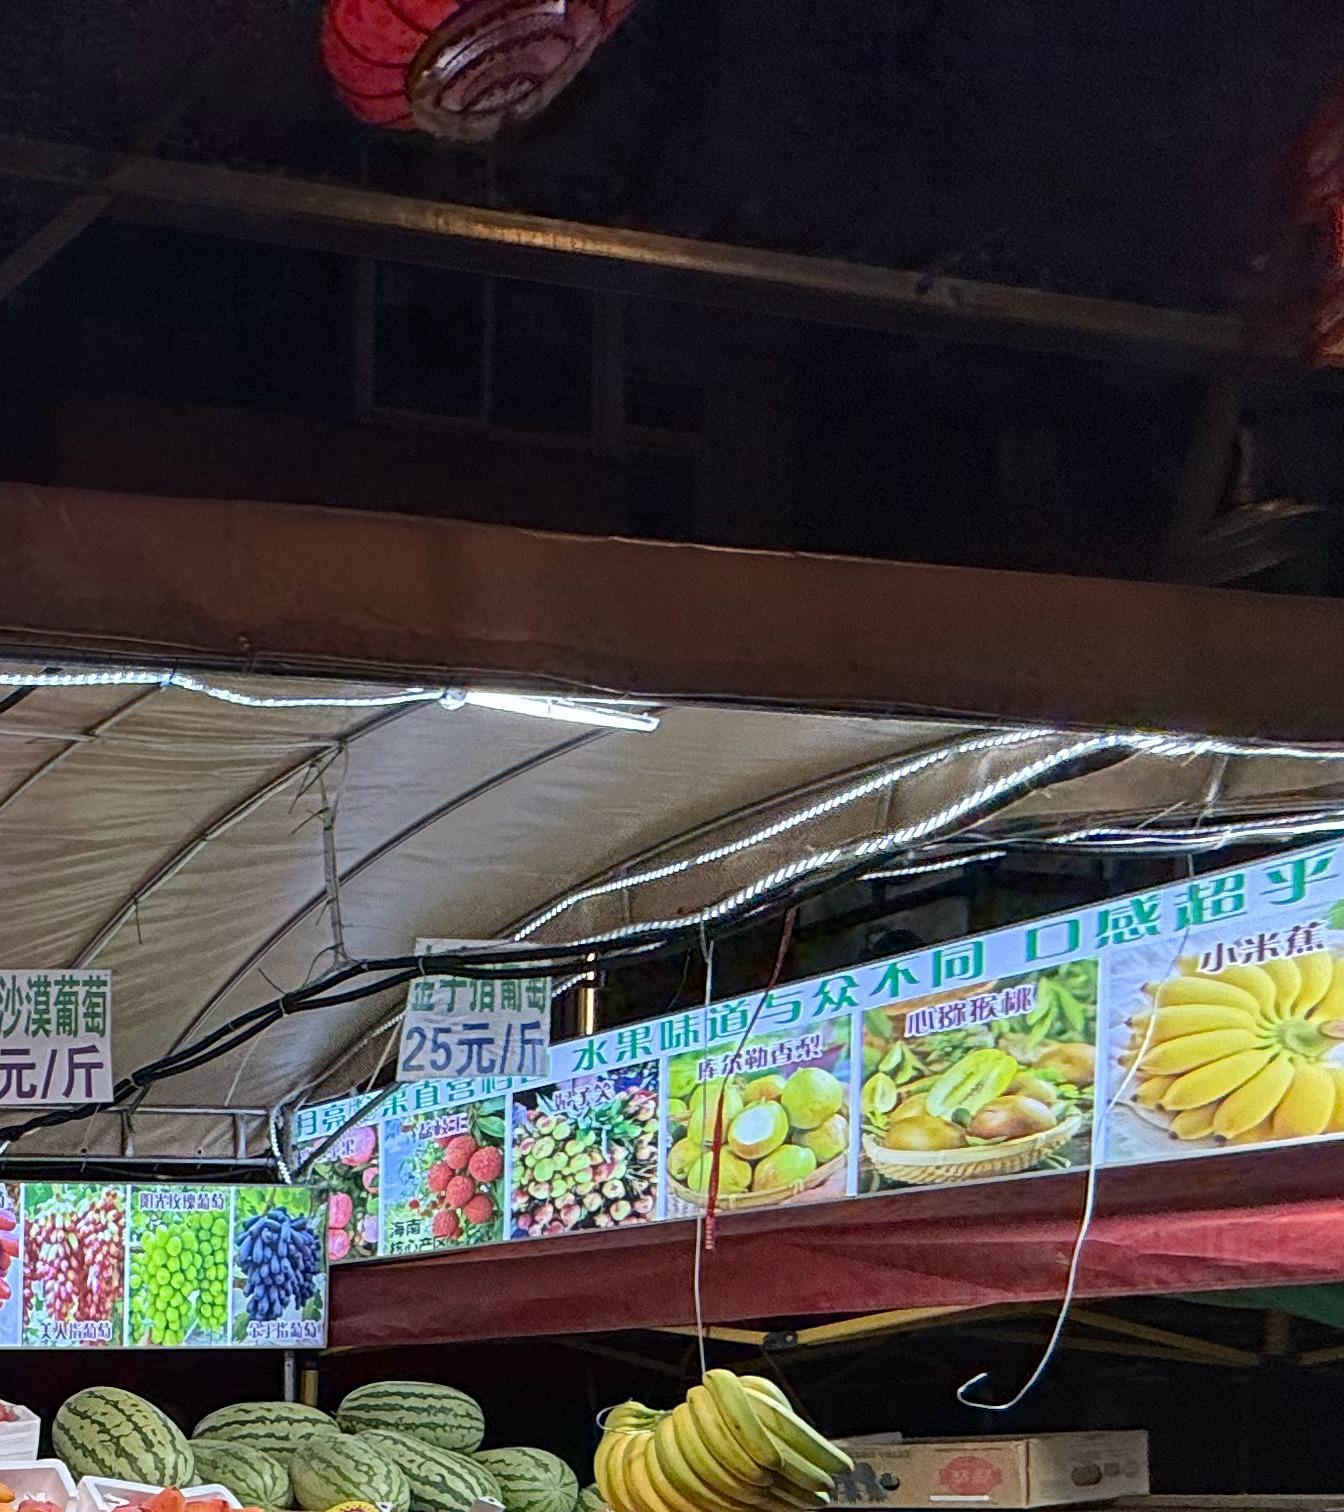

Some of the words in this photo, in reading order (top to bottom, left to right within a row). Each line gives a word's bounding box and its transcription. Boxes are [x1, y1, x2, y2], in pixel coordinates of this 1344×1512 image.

[572, 942, 984, 1071] 水果味道与众不同
[1025, 848, 1335, 960] 口感超乎
[1201, 921, 1326, 973] 小米蕉
[402, 1020, 544, 1076] 25元/斤
